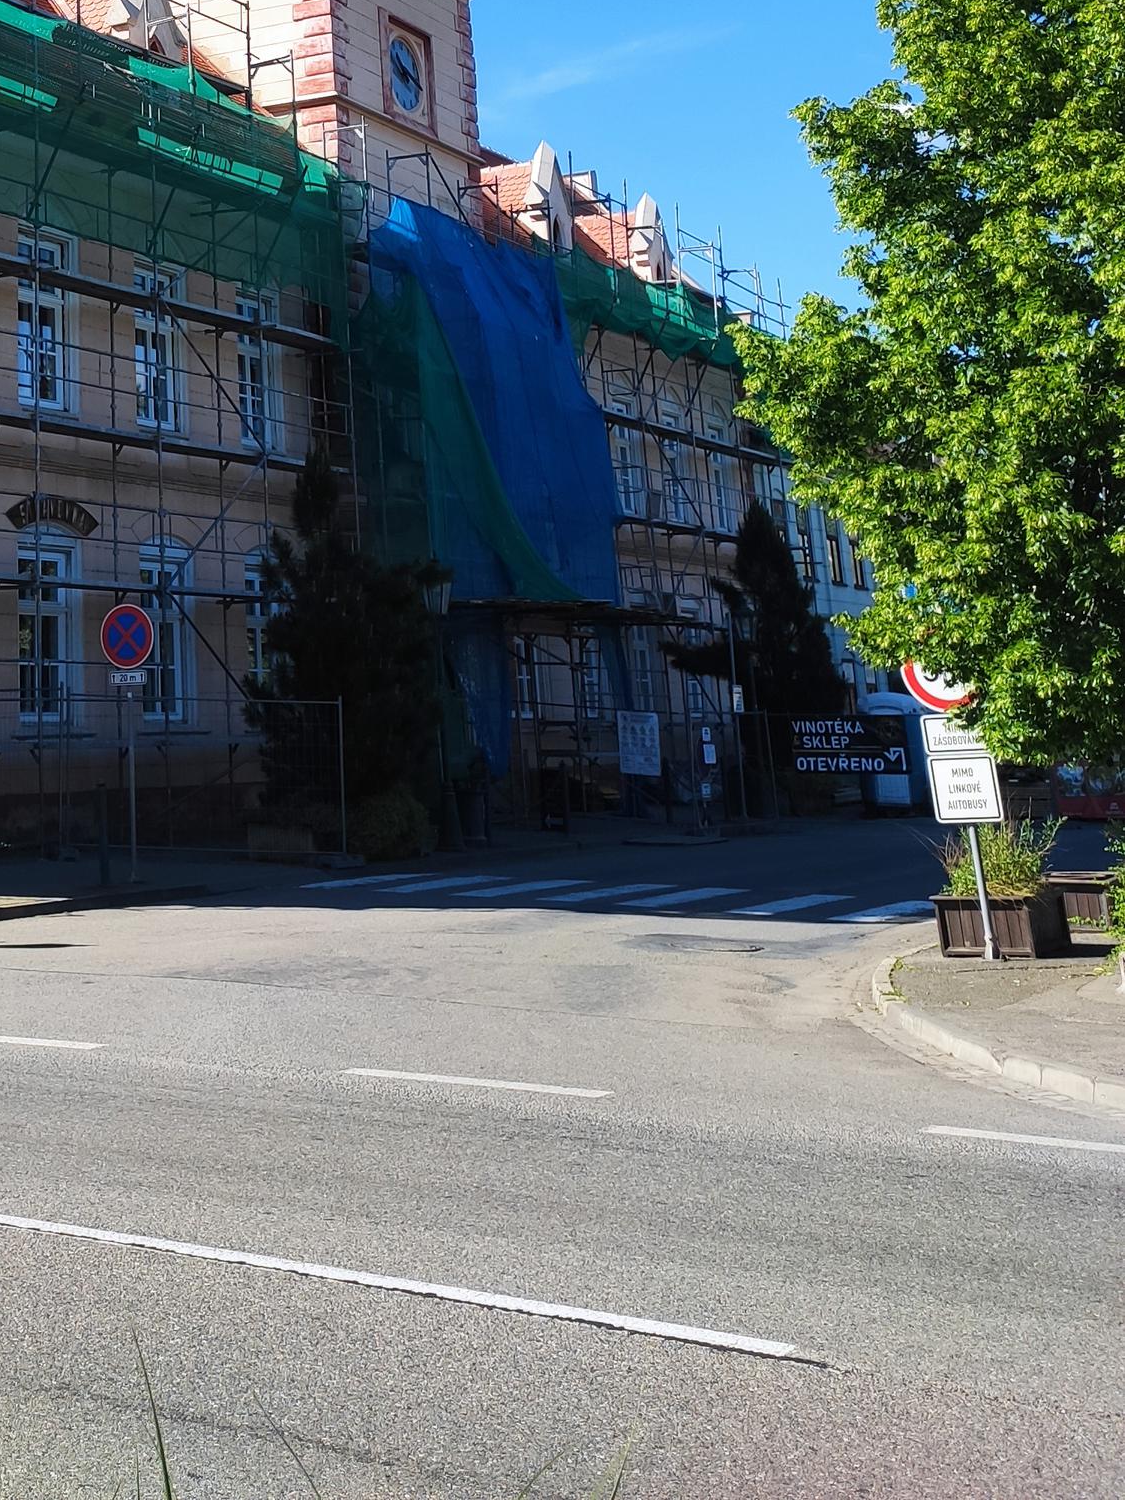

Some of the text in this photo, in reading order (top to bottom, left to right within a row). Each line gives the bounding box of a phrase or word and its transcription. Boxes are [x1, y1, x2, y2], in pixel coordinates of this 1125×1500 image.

[119, 674, 128, 682] 20
[791, 718, 864, 734] VINOTÉKA
[803, 735, 850, 749] SKLEP
[796, 753, 885, 771] OTEVŘENO
[951, 767, 974, 778] MIMO
[948, 781, 983, 794] LINKOVÉ
[947, 799, 988, 810] AUTOBUSY
